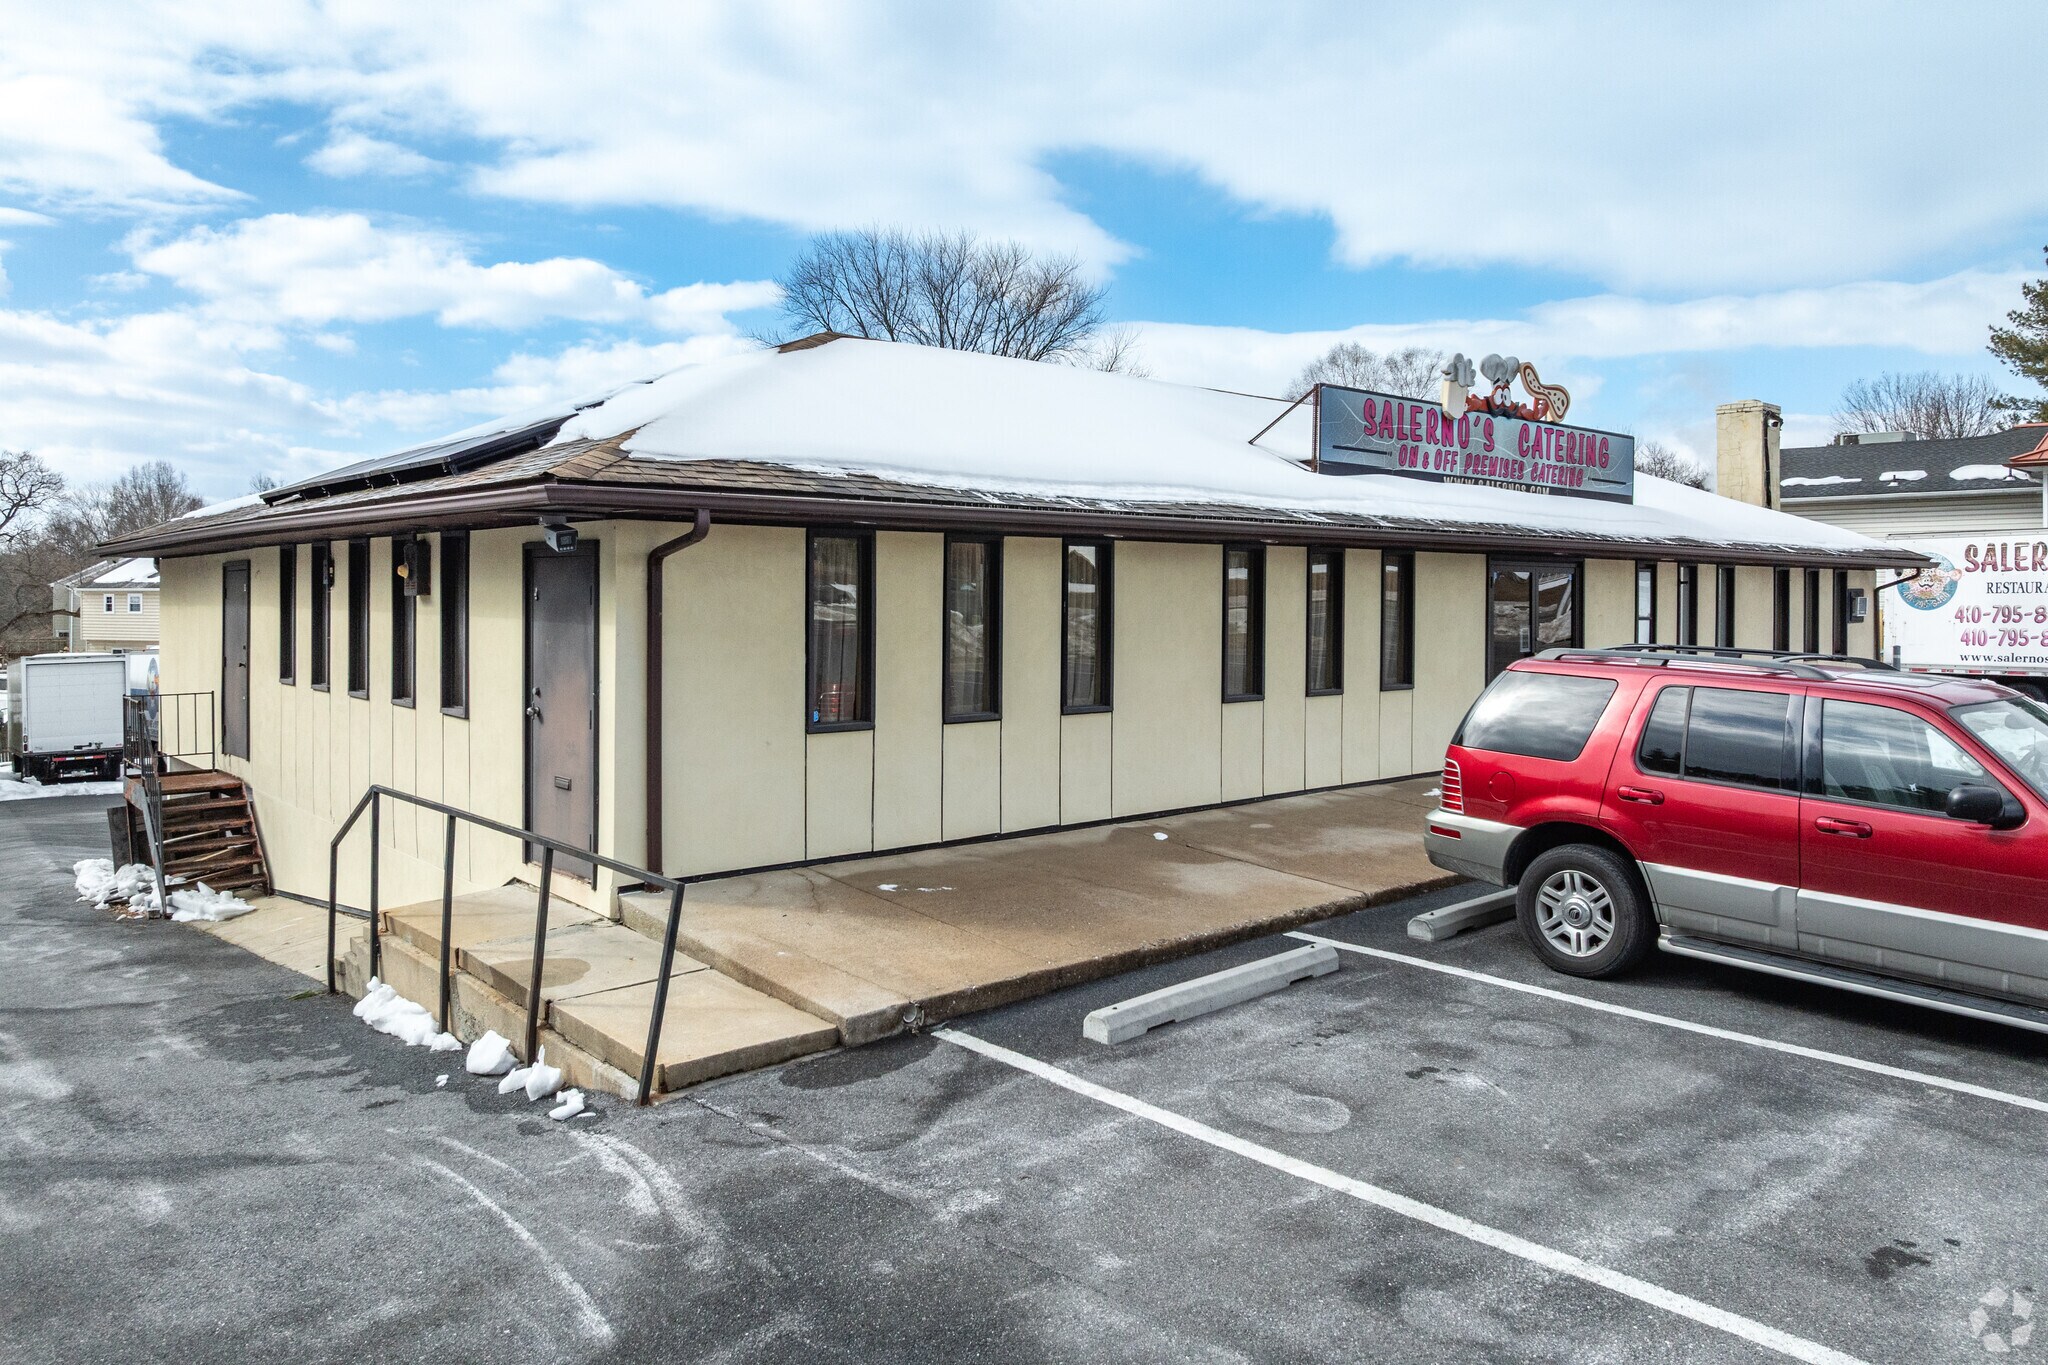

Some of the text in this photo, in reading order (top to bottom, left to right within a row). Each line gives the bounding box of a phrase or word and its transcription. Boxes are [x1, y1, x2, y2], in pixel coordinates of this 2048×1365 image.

[1363, 397, 1610, 469] SALERNO'S CATERING
[1398, 444, 1584, 487] ON & OFF PREMISES CATERING
[1964, 541, 2048, 573] SALER
